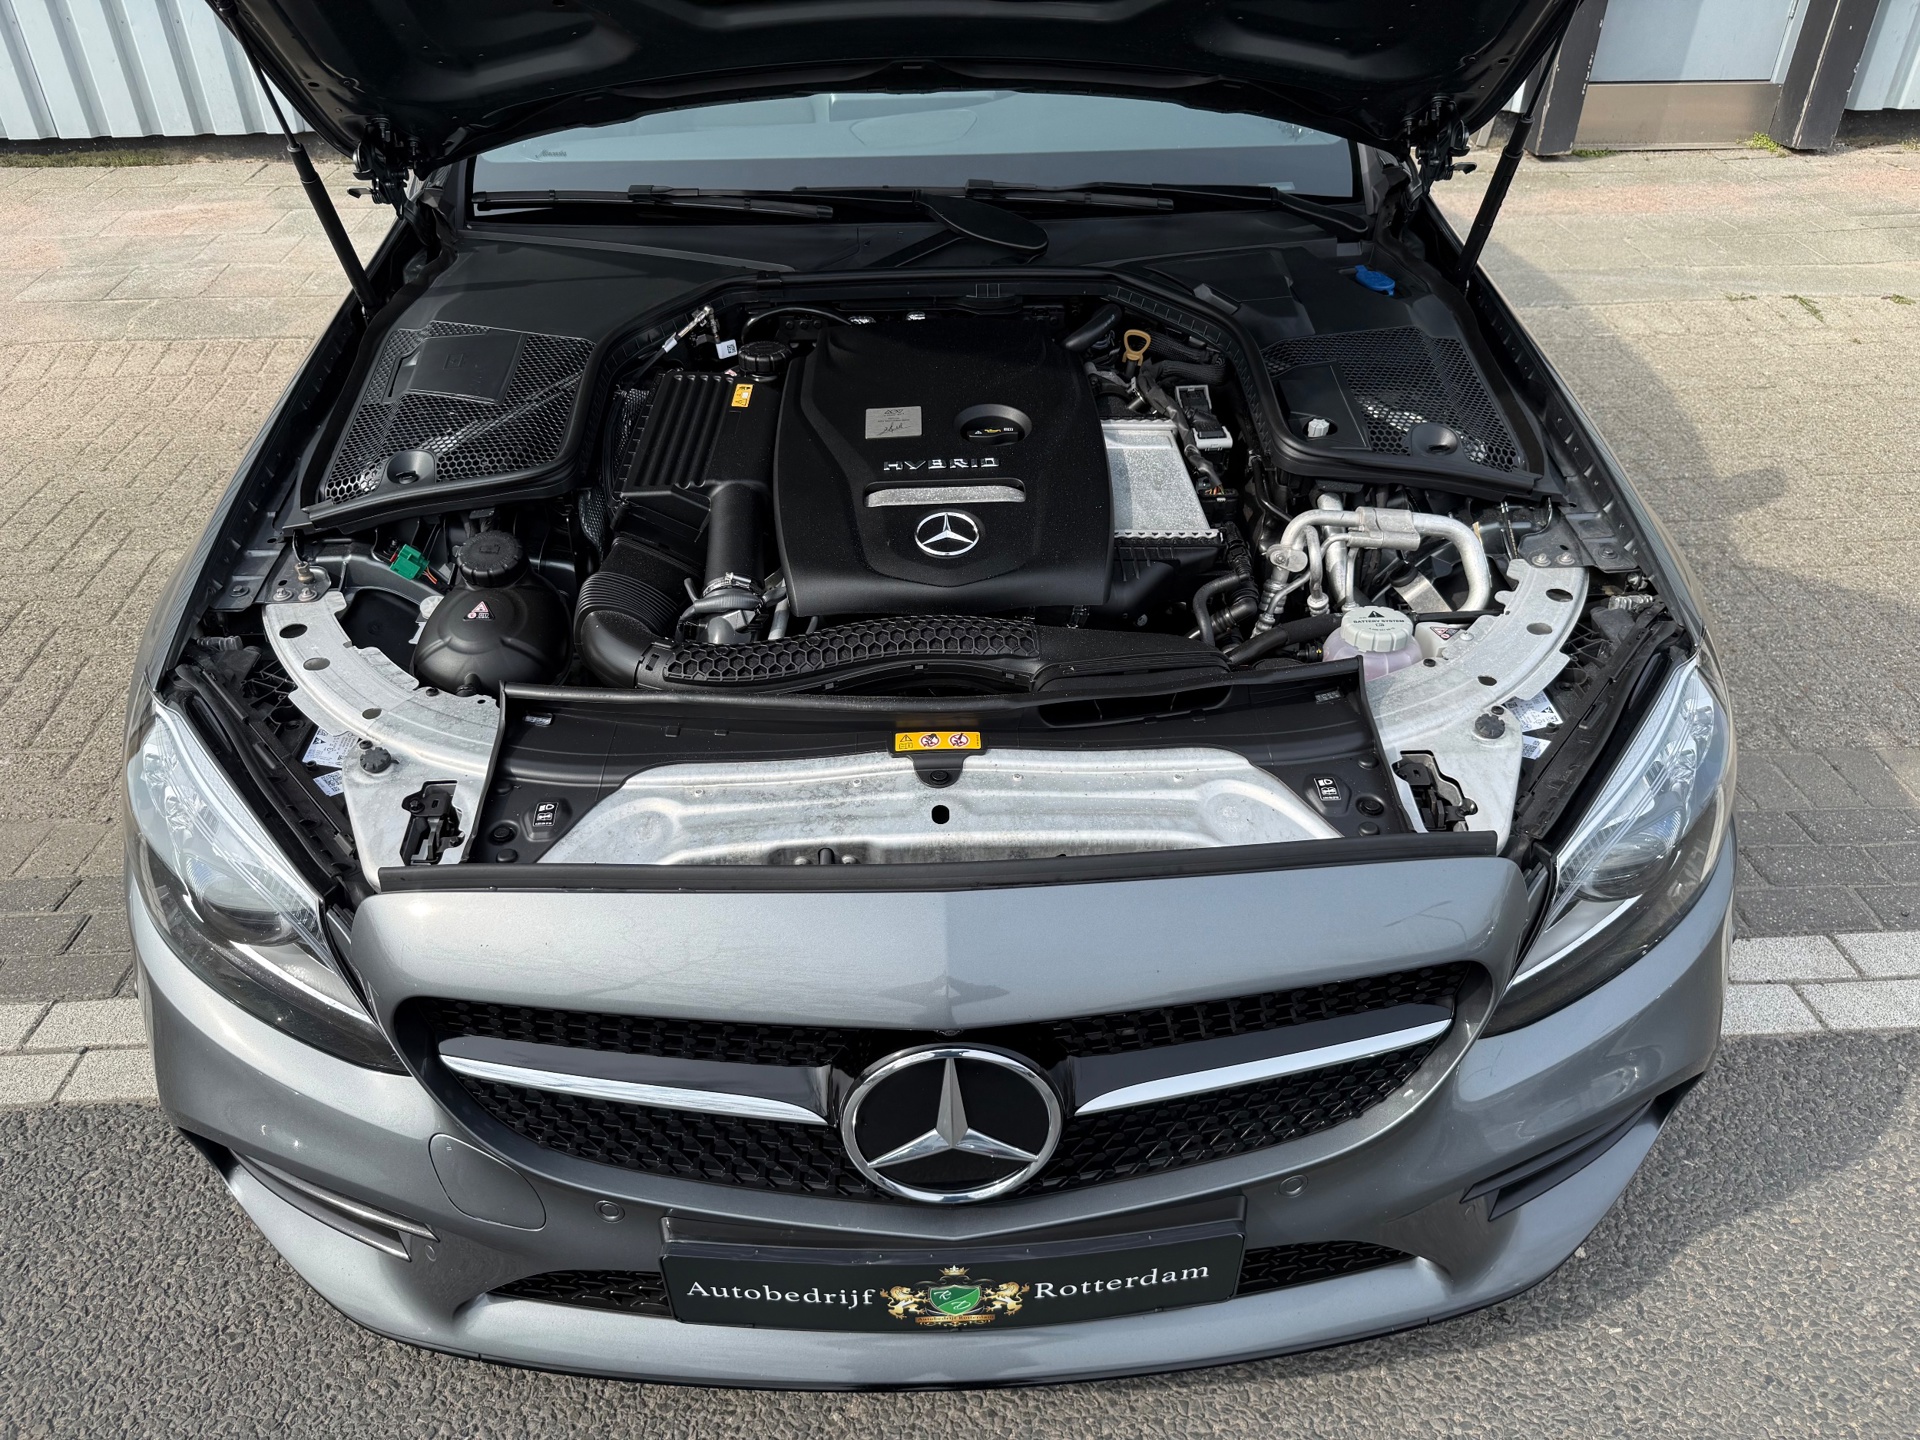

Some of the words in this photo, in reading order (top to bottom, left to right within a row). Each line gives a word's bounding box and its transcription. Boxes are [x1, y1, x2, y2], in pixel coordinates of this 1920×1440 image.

[883, 457, 999, 471] HYBRID
[686, 1281, 876, 1310] Autobedrijf
[1034, 1265, 1209, 1299] Rotterdam
